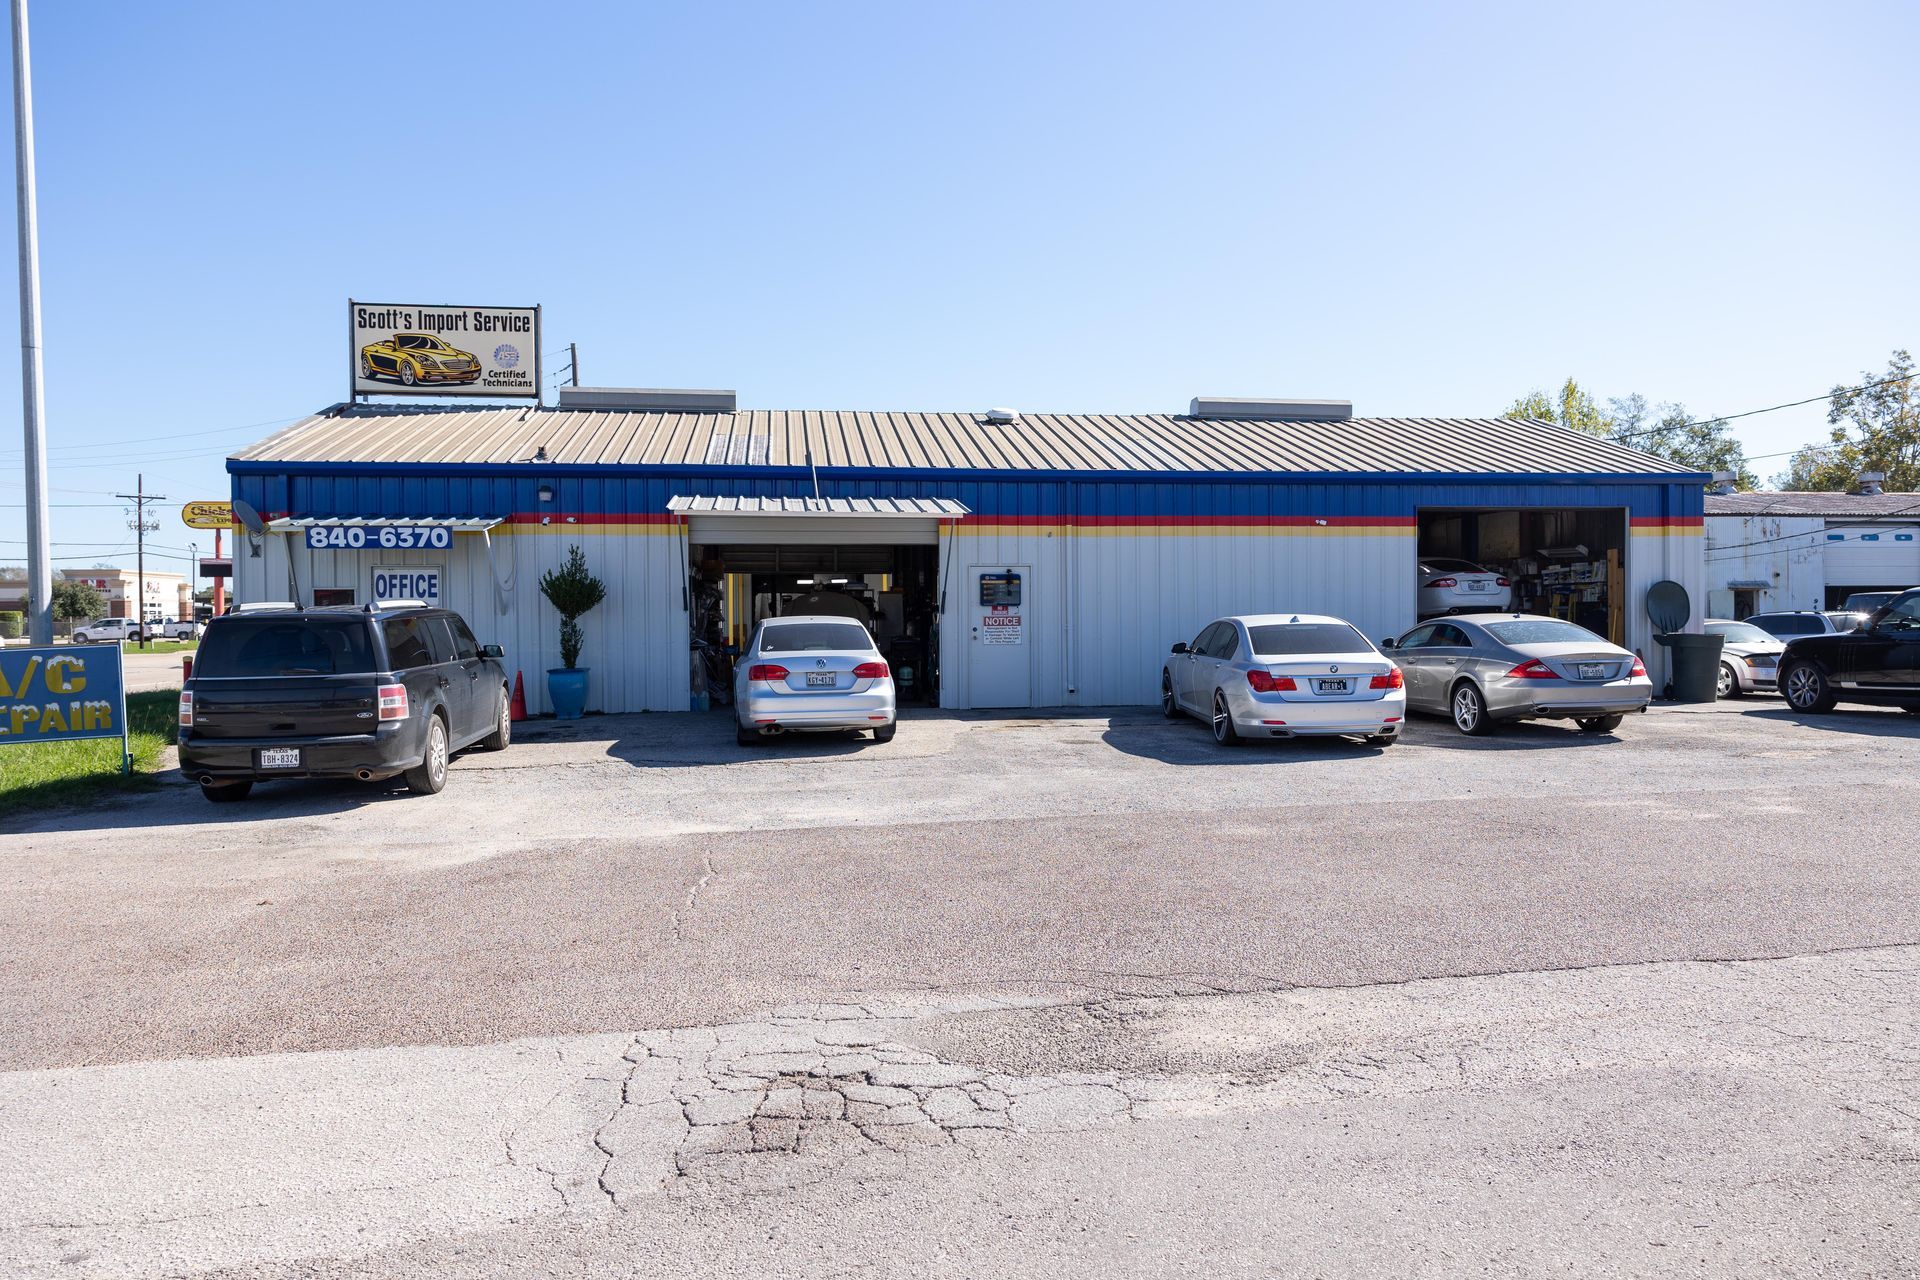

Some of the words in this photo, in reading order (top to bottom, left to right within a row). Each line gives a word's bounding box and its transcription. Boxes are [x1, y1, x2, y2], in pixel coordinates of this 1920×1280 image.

[358, 308, 412, 330] Scott's
[418, 309, 468, 334] Import
[473, 311, 531, 333] Service
[488, 370, 526, 379] Certified
[482, 378, 532, 387] Technicians
[309, 527, 449, 548] 840-6370
[375, 573, 438, 598] OFFICE
[985, 617, 1019, 626] NOTICE
